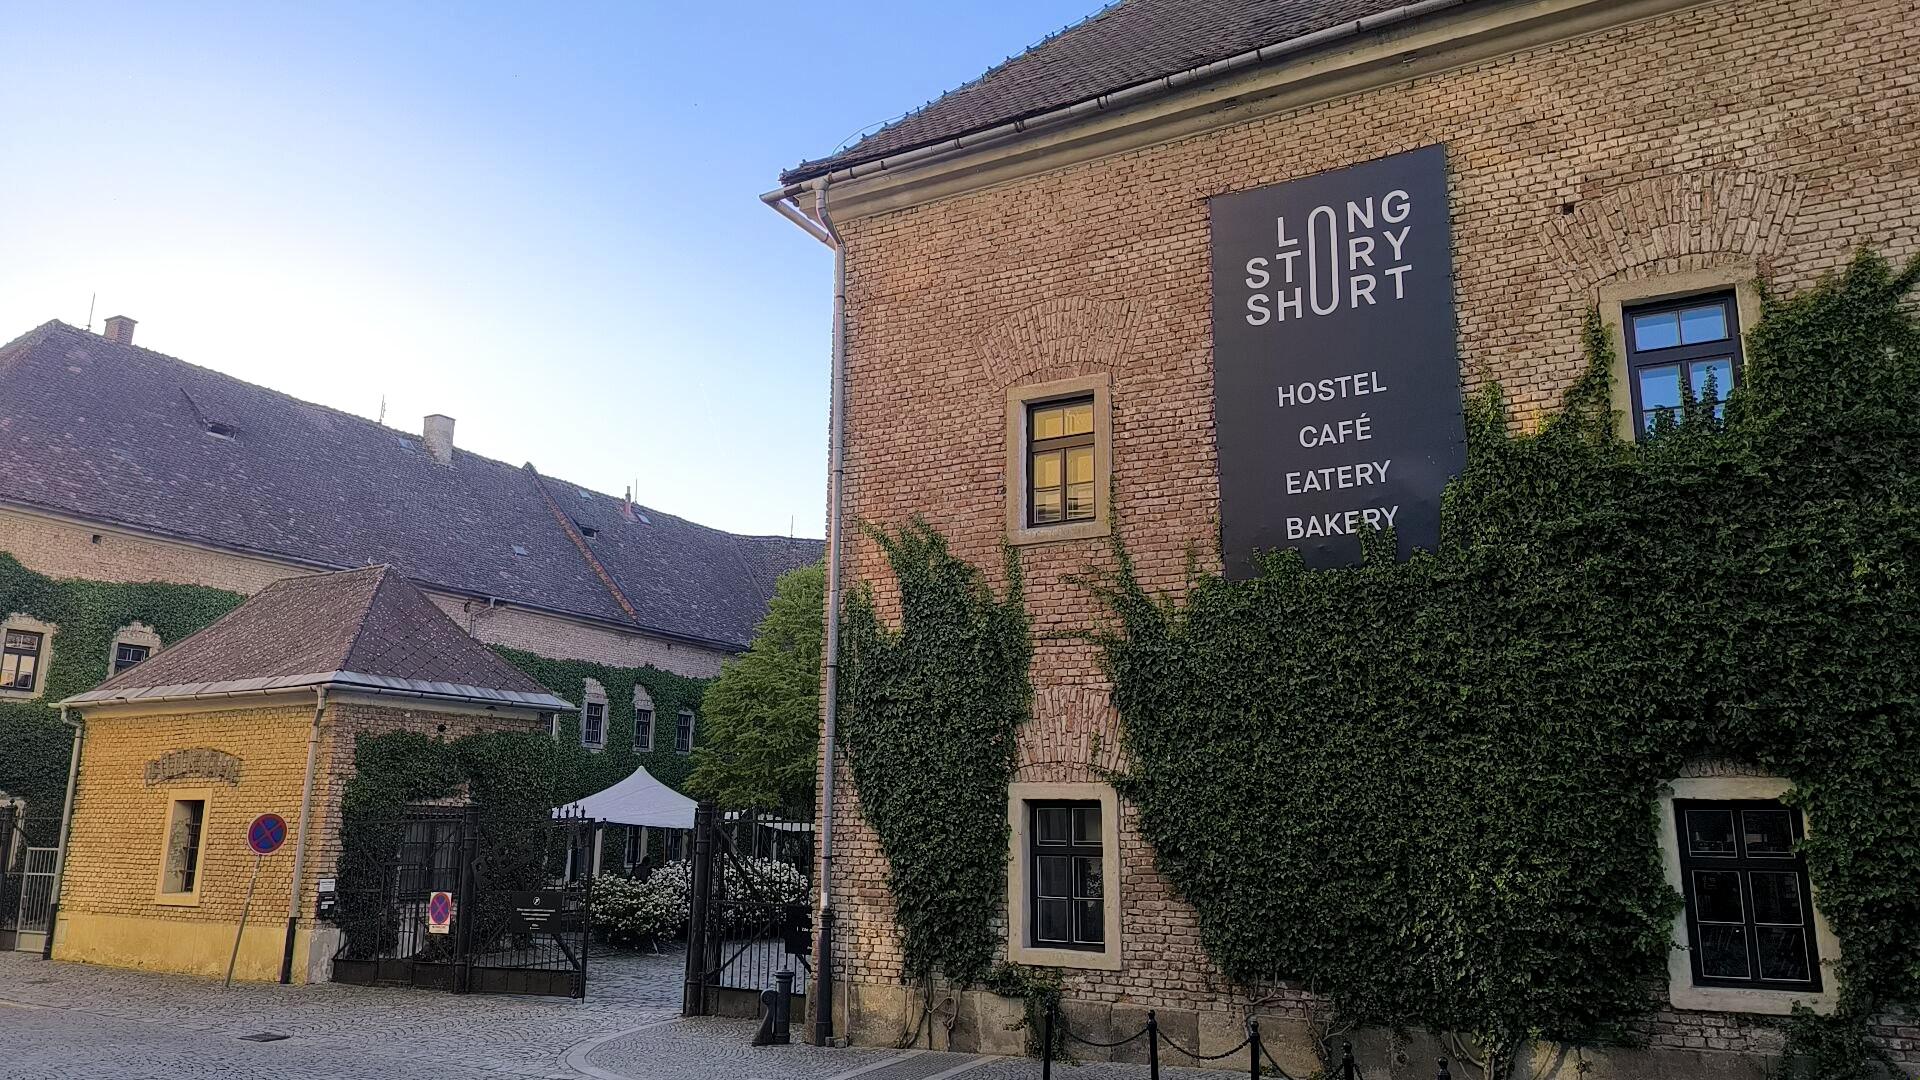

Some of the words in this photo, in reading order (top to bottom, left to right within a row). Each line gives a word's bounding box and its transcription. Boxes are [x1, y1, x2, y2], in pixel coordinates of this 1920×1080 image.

[1245, 225, 1412, 290] STORY
[1245, 263, 1414, 327] SHORT
[1277, 371, 1387, 408] HOSTEL
[1298, 412, 1372, 449] CAFÉ
[1285, 459, 1391, 495] EATERY
[1286, 505, 1399, 540] BAKERY
